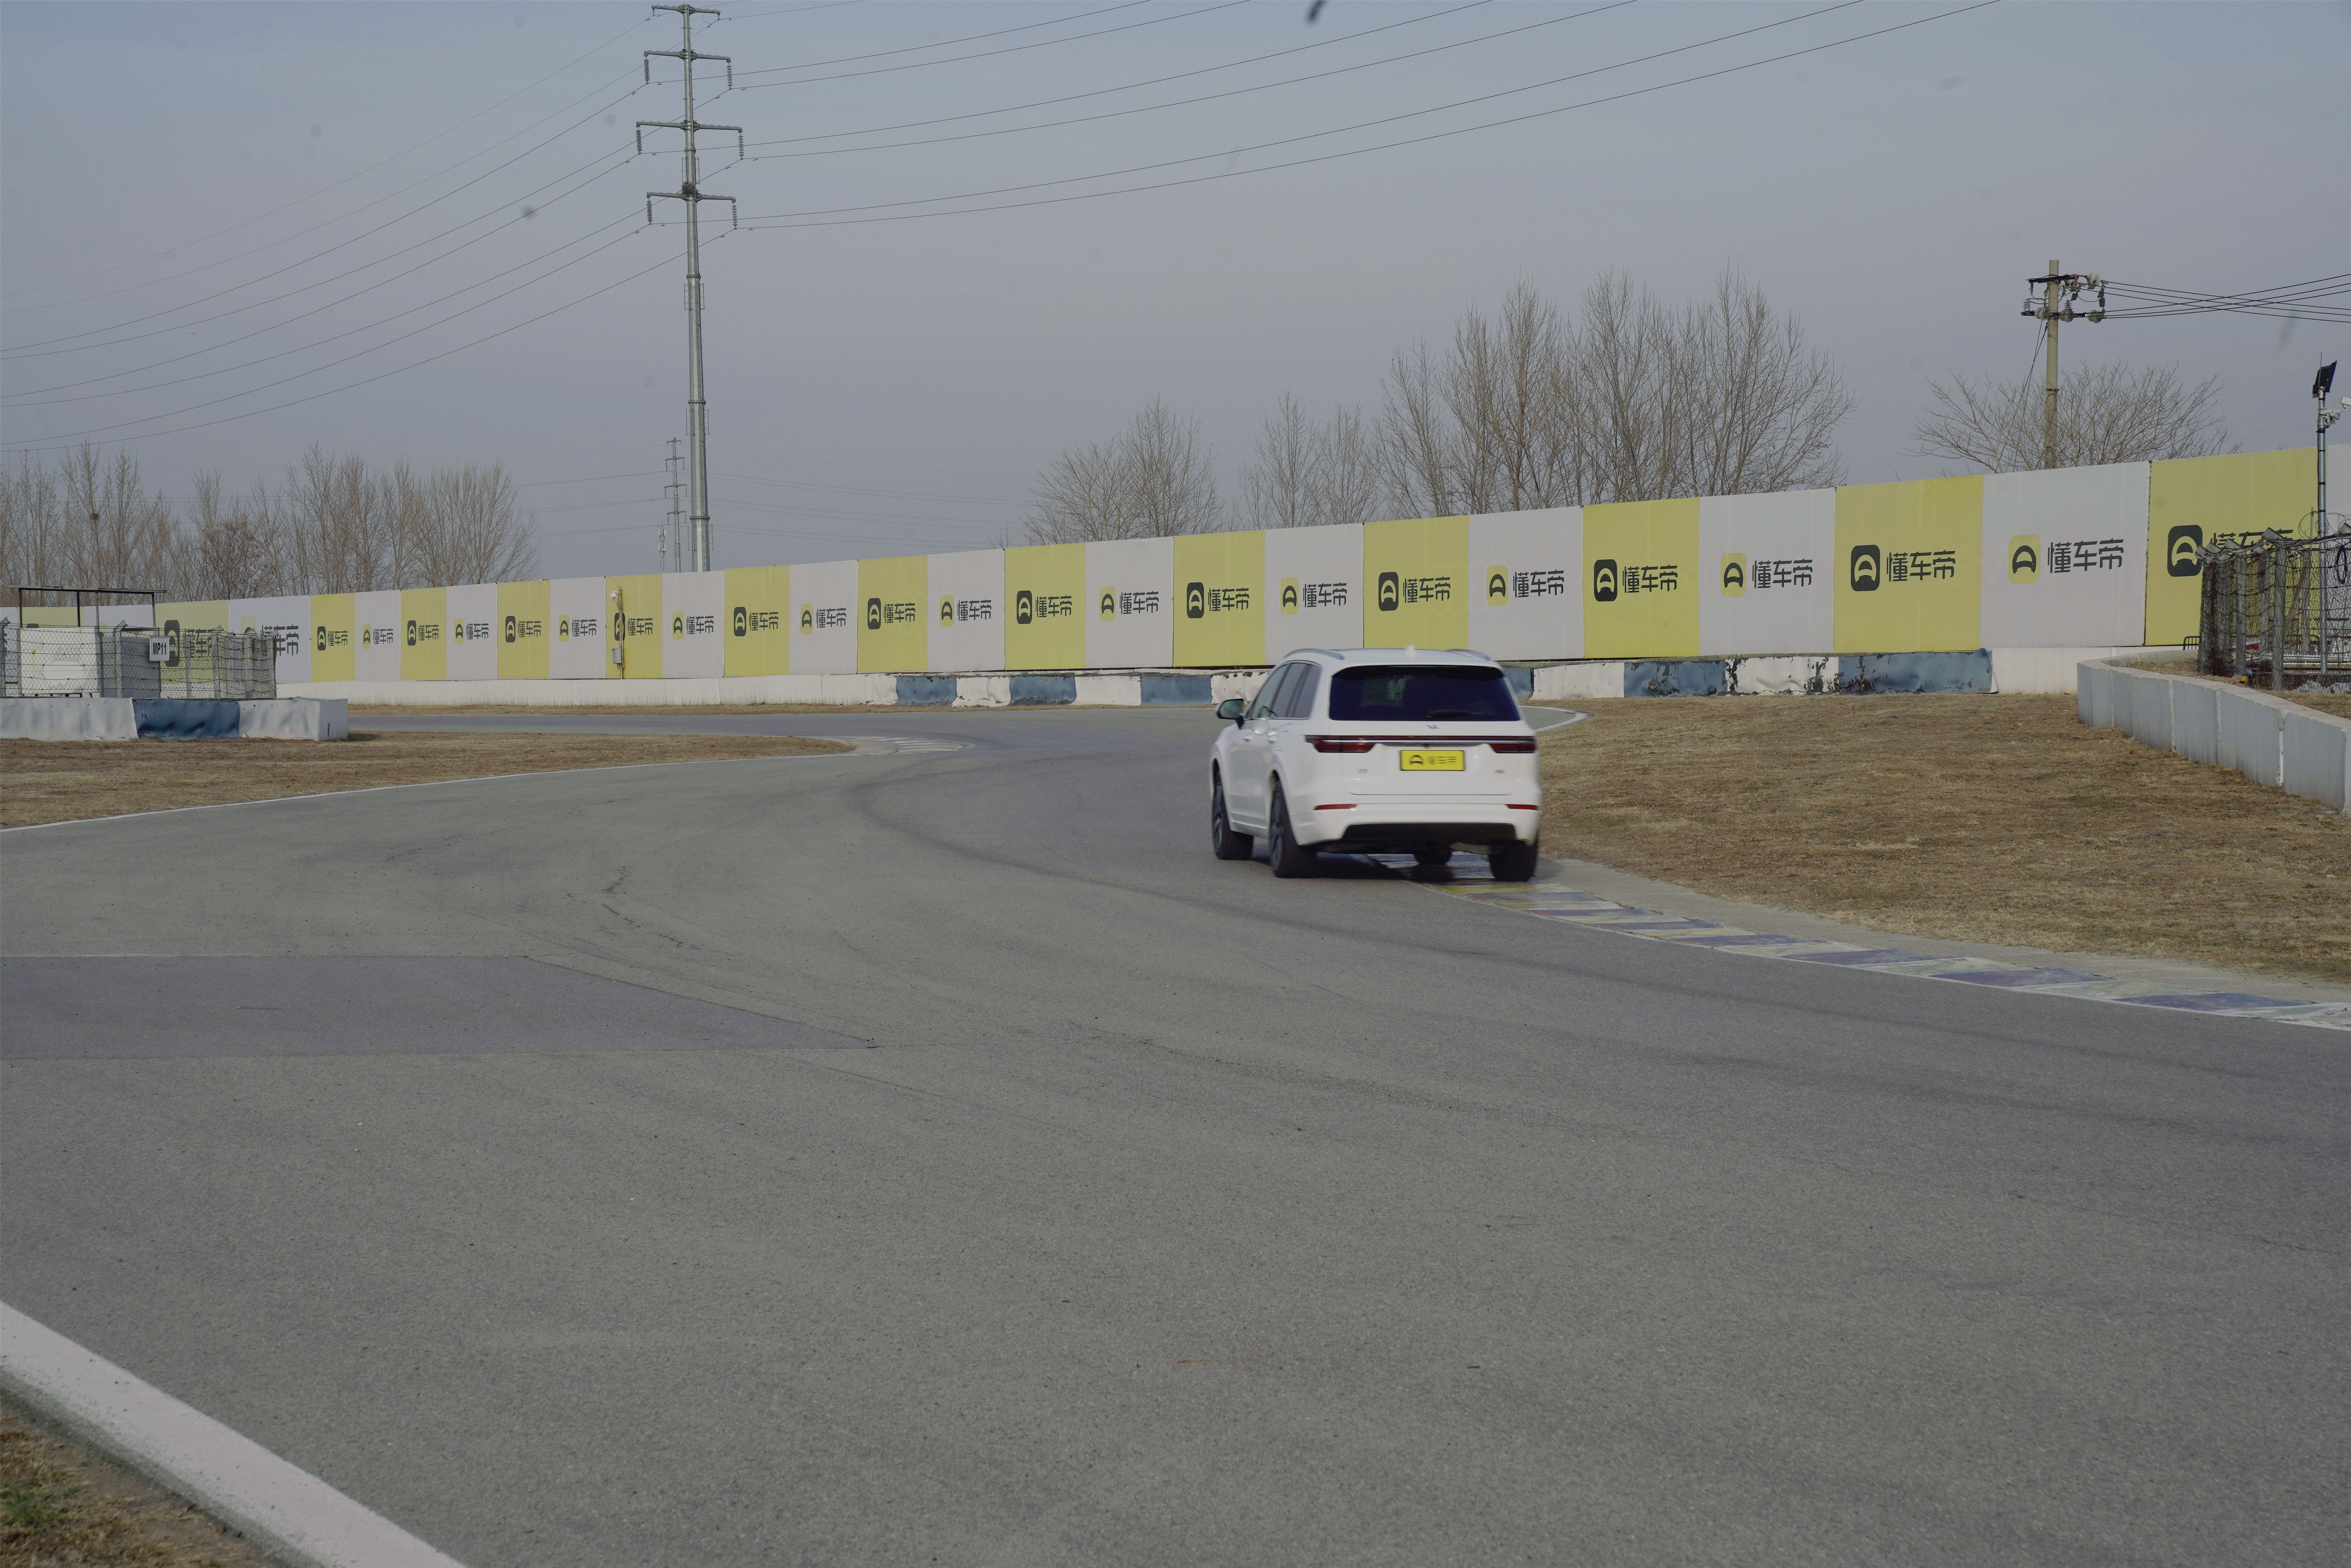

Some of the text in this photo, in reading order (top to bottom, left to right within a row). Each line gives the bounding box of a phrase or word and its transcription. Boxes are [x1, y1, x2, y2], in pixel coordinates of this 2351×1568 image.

[1886, 549, 1956, 582] 懂车帝
[2047, 538, 2124, 573] 懂车帝
[1513, 569, 1565, 598] 懂车帝
[1622, 564, 1678, 593] 懂车帝
[1752, 558, 1813, 588] 懂车帝
[1208, 587, 1250, 612] 懂车帝
[1303, 582, 1347, 608] 懂车帝
[1403, 576, 1451, 603] 懂车帝
[884, 602, 916, 623] 懂车帝
[957, 599, 992, 621] 懂车帝
[1035, 595, 1072, 617] 懂车帝
[1119, 590, 1159, 614] 懂车帝
[572, 618, 597, 637] 懂车帝
[627, 617, 653, 636] 懂车帝
[686, 615, 714, 634] 懂车帝
[749, 611, 779, 631] 懂车帝
[816, 607, 846, 628] 懂车帝
[328, 630, 348, 646] 懂车帝
[373, 628, 393, 645] 懂车帝
[418, 624, 439, 641] 懂车帝
[466, 623, 489, 640] 懂车帝
[518, 620, 542, 637] 懂车帝
[153, 642, 167, 655] MP11
